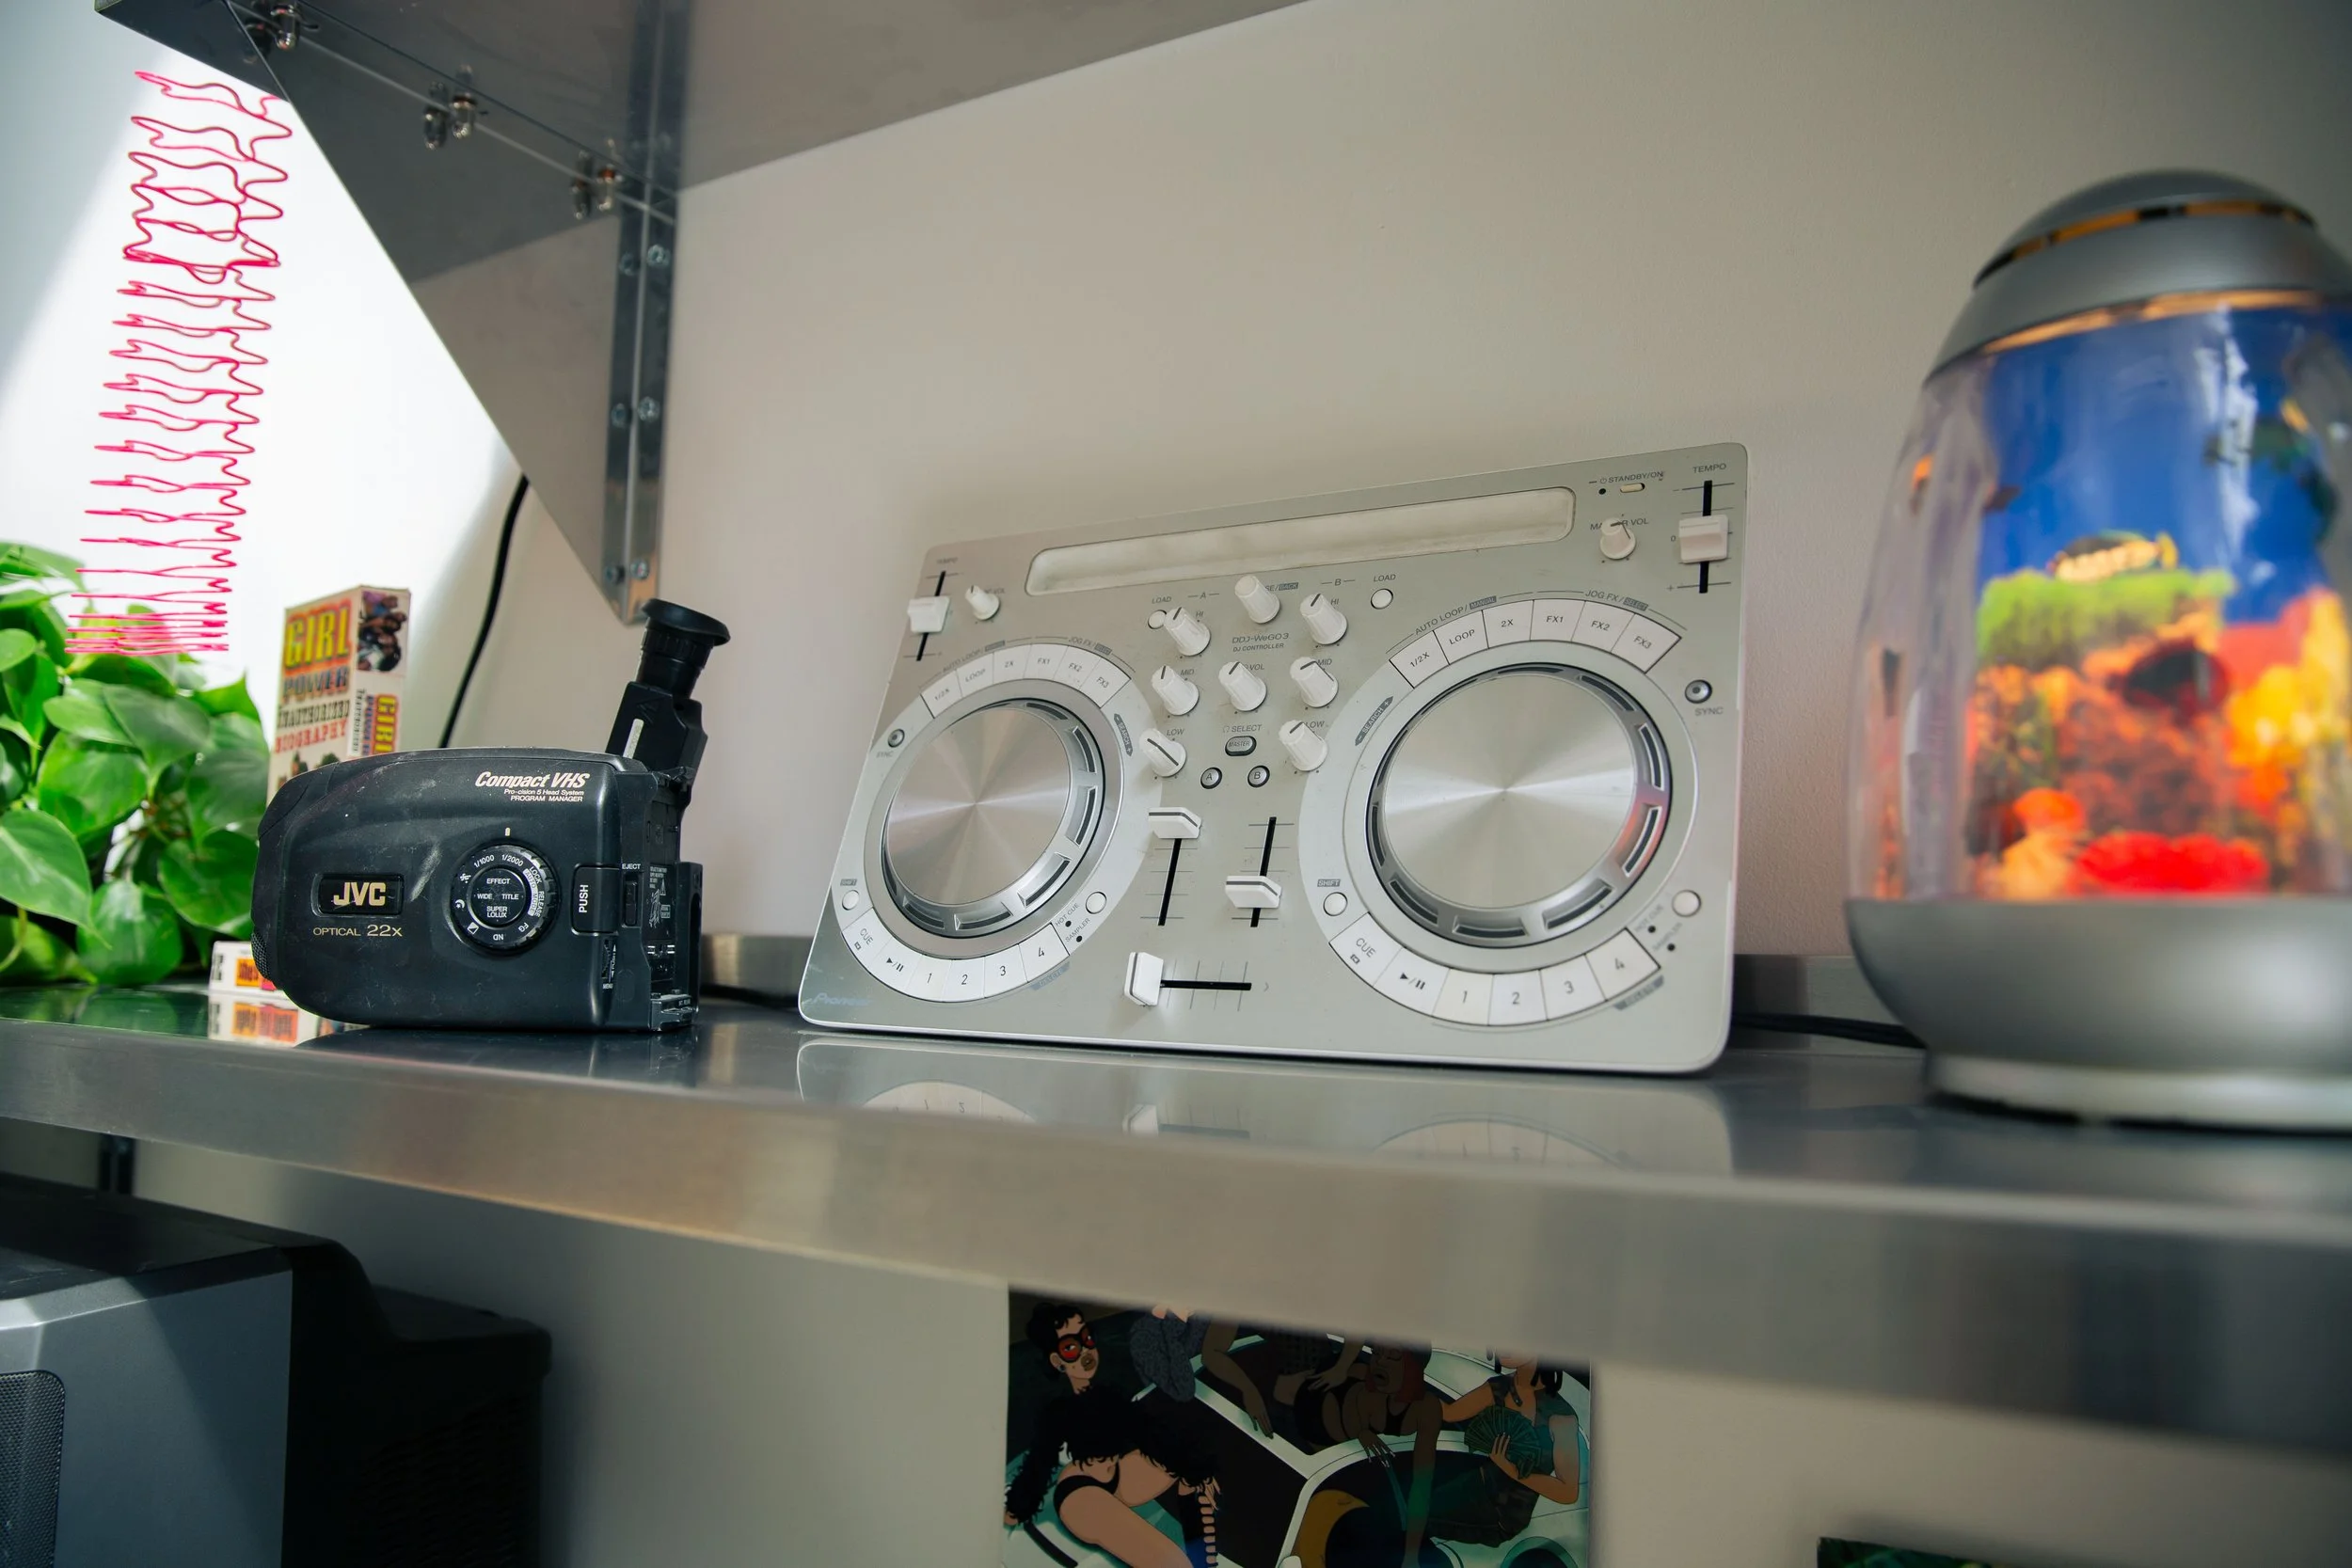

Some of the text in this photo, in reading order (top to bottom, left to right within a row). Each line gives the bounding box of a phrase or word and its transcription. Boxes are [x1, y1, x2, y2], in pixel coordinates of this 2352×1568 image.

[1692, 463, 1726, 474] TEMPO
[1609, 471, 1663, 483] STANDBY/ON
[1590, 520, 1629, 531] MAR
[1374, 574, 1396, 582] LOAD
[1152, 595, 1172, 605] LOAD
[1585, 589, 1605, 599] JOG
[1501, 619, 1514, 627] 2X
[1547, 615, 1564, 624] FX1
[1591, 620, 1611, 631] FX2
[1415, 618, 1438, 636] AUTO
[283, 605, 352, 671] GIRL
[1449, 628, 1475, 645] LOOP
[1633, 635, 1652, 649] FX3
[1242, 643, 1284, 652] CONTROLLER
[1038, 657, 1050, 666] FX1
[1409, 651, 1430, 668] 1/2X
[1069, 662, 1083, 673] FX2
[965, 668, 986, 683] LOOP
[283, 666, 349, 702] POWER
[1096, 677, 1110, 689] FX3
[1694, 707, 1724, 717] SYNC
[1305, 721, 1325, 729] LOW
[1361, 707, 1384, 734] SEARCH
[1118, 721, 1131, 747] SEARCH
[1167, 728, 1185, 736] LOW
[1231, 724, 1263, 733] SELECT
[275, 718, 348, 754] BIOGRAPHY
[474, 771, 591, 789] Compact VHS
[473, 854, 524, 868] 1/1000 1/2000
[333, 881, 387, 907] JVC
[529, 865, 545, 918] LOCK RELEASE
[578, 884, 589, 913] PUSH
[1055, 903, 1080, 927] HOT CUE
[312, 927, 361, 937] OPTICAL
[517, 922, 530, 933] FG
[1065, 918, 1091, 942] SAMPLER
[860, 927, 873, 945] CUE
[1038, 946, 1045, 958] 4
[1355, 937, 1376, 958] CUE
[1614, 958, 1625, 970] 4
[999, 965, 1007, 976] 3
[928, 973, 933, 984] 1
[961, 974, 968, 986] 2
[1564, 980, 1574, 994] 3
[1462, 990, 1468, 1004] 1
[1511, 991, 1520, 1005] 2
